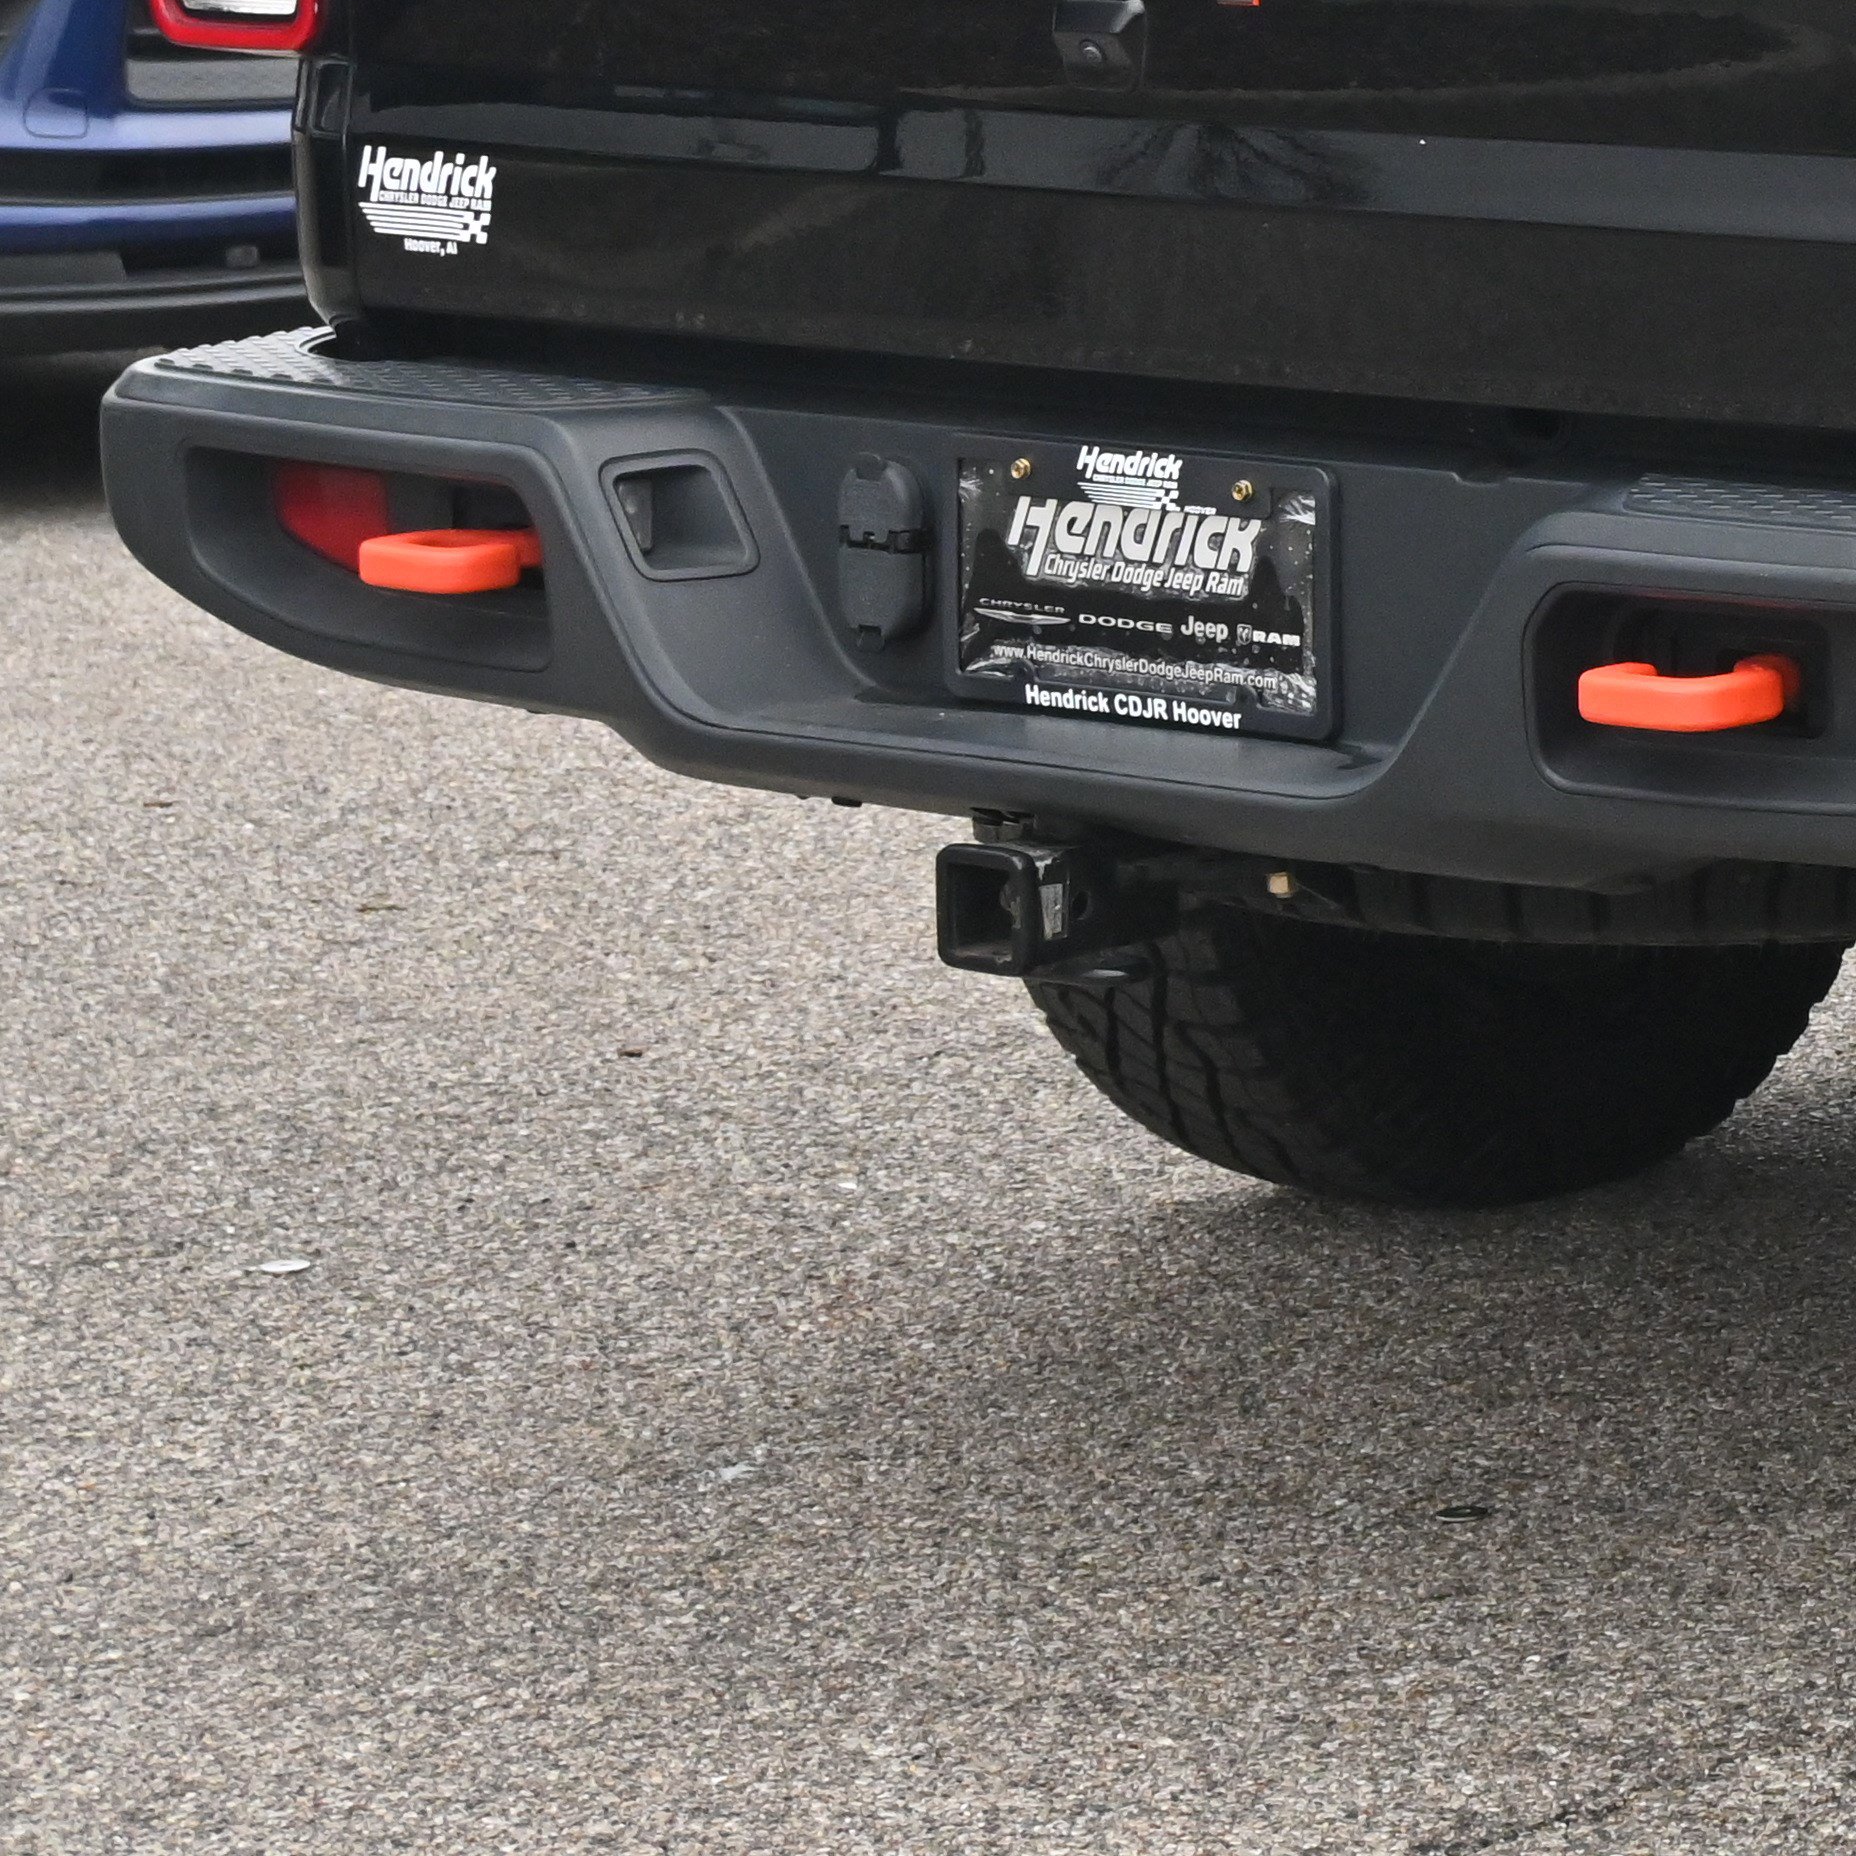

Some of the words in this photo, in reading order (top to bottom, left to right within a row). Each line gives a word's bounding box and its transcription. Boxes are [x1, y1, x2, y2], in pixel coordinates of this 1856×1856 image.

[357, 144, 498, 203] Hendrick
[1076, 445, 1183, 480] Hendrick
[1006, 495, 1261, 577] Hendrick
[1044, 552, 1109, 584] Chrysler
[1111, 559, 1164, 592] Dodge
[1164, 564, 1205, 596] Jeep
[1205, 571, 1245, 596] Ram
[978, 597, 1066, 614] CHRYSLER
[1078, 613, 1173, 634] DODGE
[1180, 615, 1229, 642] Jeep
[1252, 629, 1301, 647] RAM
[993, 645, 1278, 690] www.HendrickChryslerDodgeJeepRam.com
[1025, 684, 1110, 714] Hendrick
[1114, 693, 1169, 721] CDJR
[1172, 700, 1242, 730] Hoover
